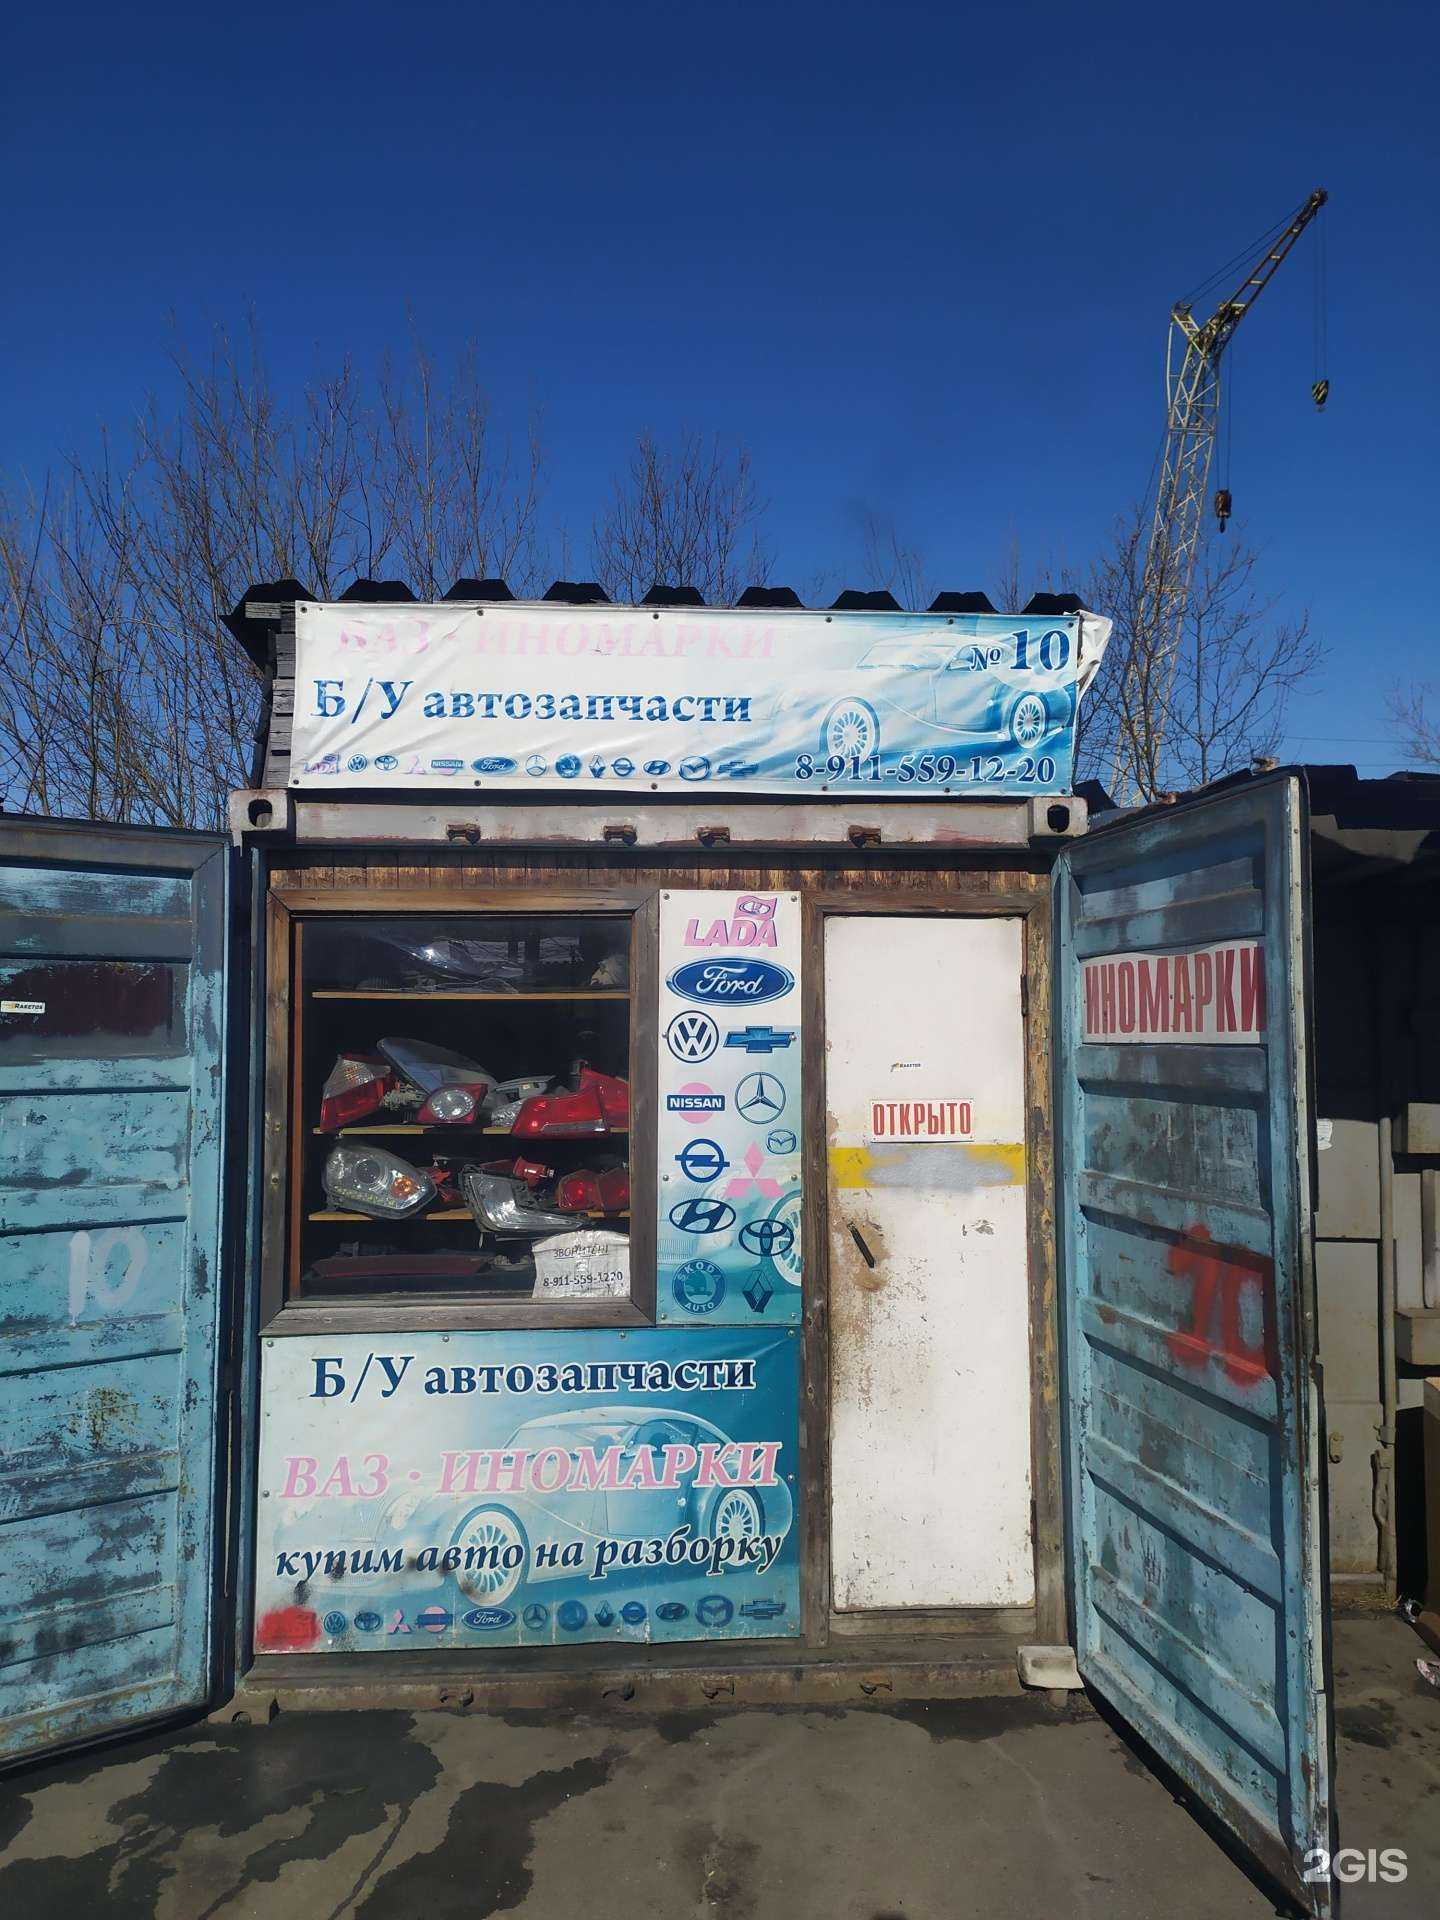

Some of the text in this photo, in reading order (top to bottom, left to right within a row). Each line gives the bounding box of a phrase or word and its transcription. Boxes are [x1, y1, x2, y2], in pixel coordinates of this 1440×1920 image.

[471, 621, 776, 659] ИНОМАРКИ
[1009, 629, 1071, 672] 10
[310, 677, 752, 723] Б/У автозапчасти
[432, 759, 463, 768] NISSAN
[480, 758, 509, 773] Ford
[795, 753, 1055, 784] 8-911-559-12-20
[684, 918, 777, 947] LADA
[696, 965, 763, 995] Ford
[1085, 946, 1267, 1034] ИНОМАРКИ
[669, 1097, 722, 1109] NISSAN
[873, 1102, 972, 1136] ОТКРЫТО
[68, 1228, 149, 1326] 10
[684, 1301, 716, 1312] AUTO
[309, 1353, 755, 1403] Б/У автозапчасти
[279, 1442, 782, 1498] ВАЗ ИНОМАРКИ
[276, 1524, 782, 1582] купим авто на разборку
[472, 1611, 503, 1625] Ford
